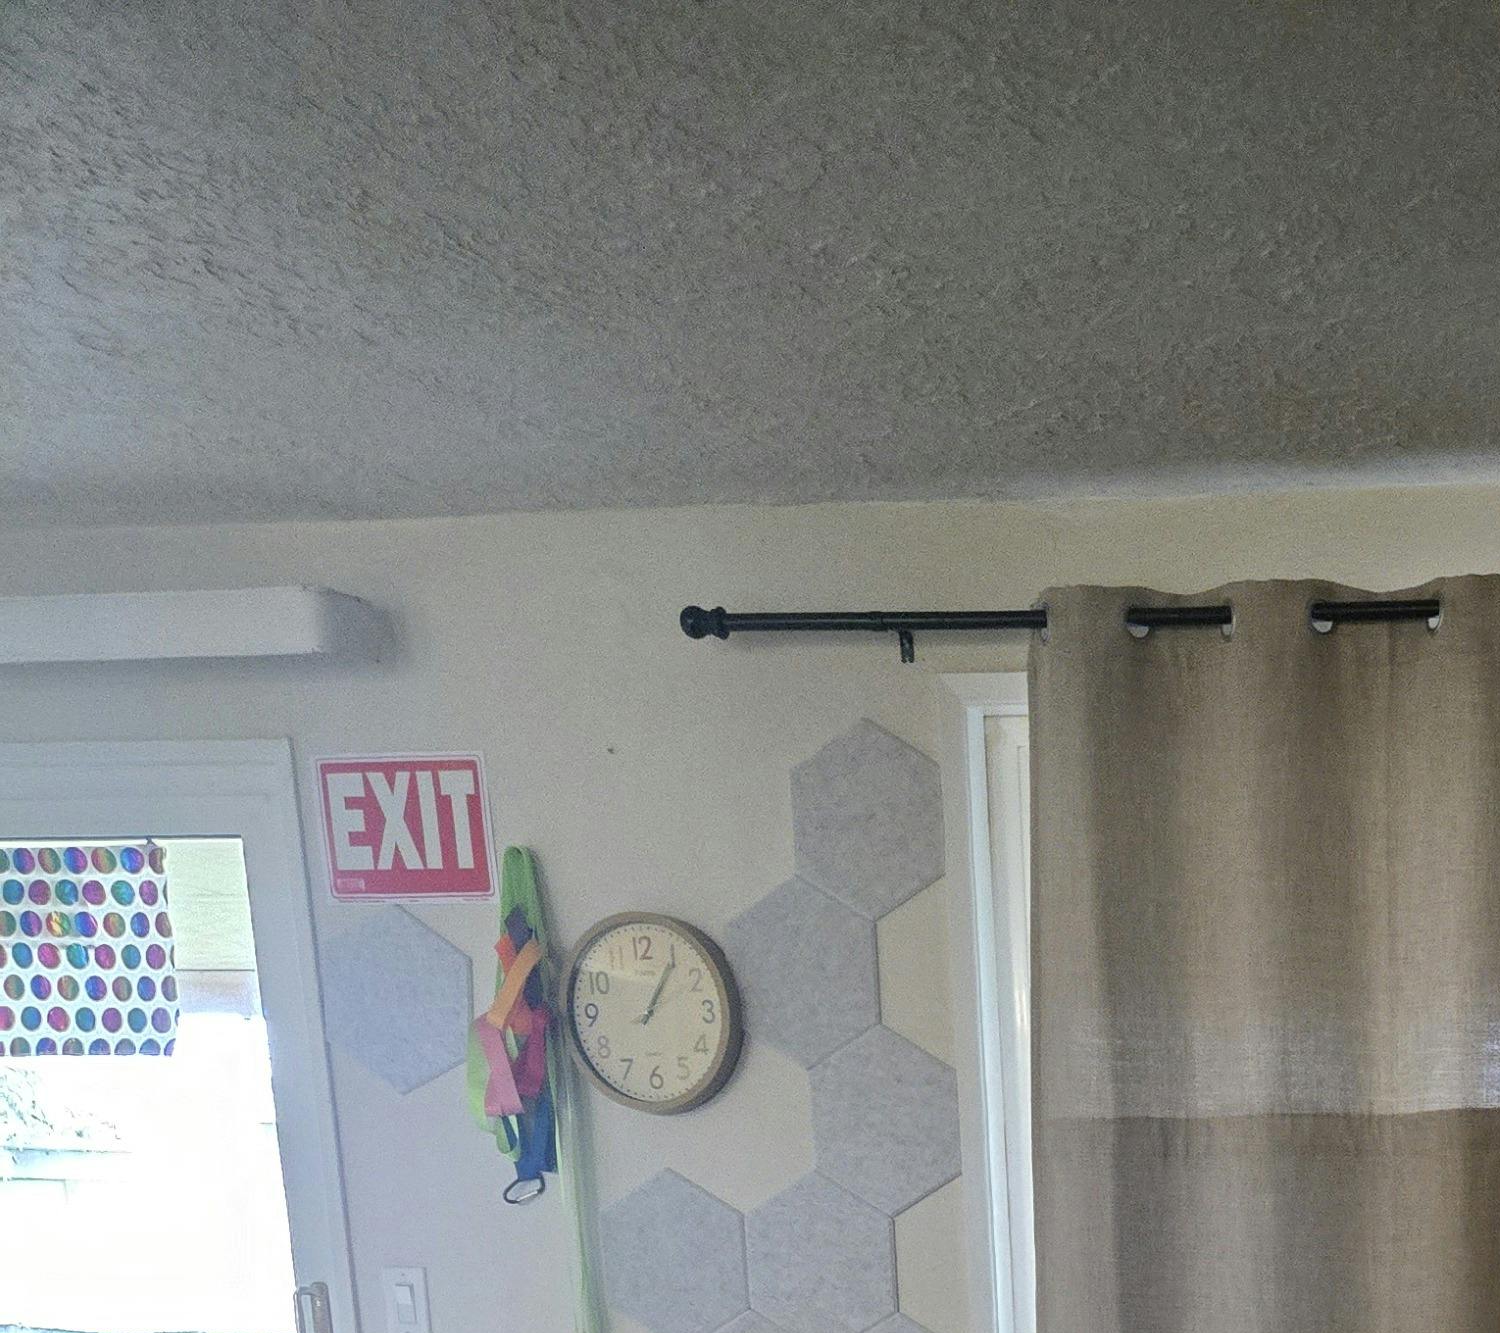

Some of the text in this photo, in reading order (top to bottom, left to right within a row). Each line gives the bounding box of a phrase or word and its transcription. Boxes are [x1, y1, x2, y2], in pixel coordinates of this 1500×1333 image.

[326, 769, 475, 870] EXIT
[609, 945, 624, 970] 11
[632, 936, 653, 961] 12
[588, 971, 610, 995] 10
[688, 967, 703, 992] 2
[584, 1003, 599, 1028] 9
[701, 999, 716, 1024] 3
[597, 1035, 611, 1059] 8
[694, 1034, 709, 1055] 4
[620, 1058, 634, 1081] 7
[649, 1065, 664, 1089] 6
[676, 1056, 690, 1080] 5
